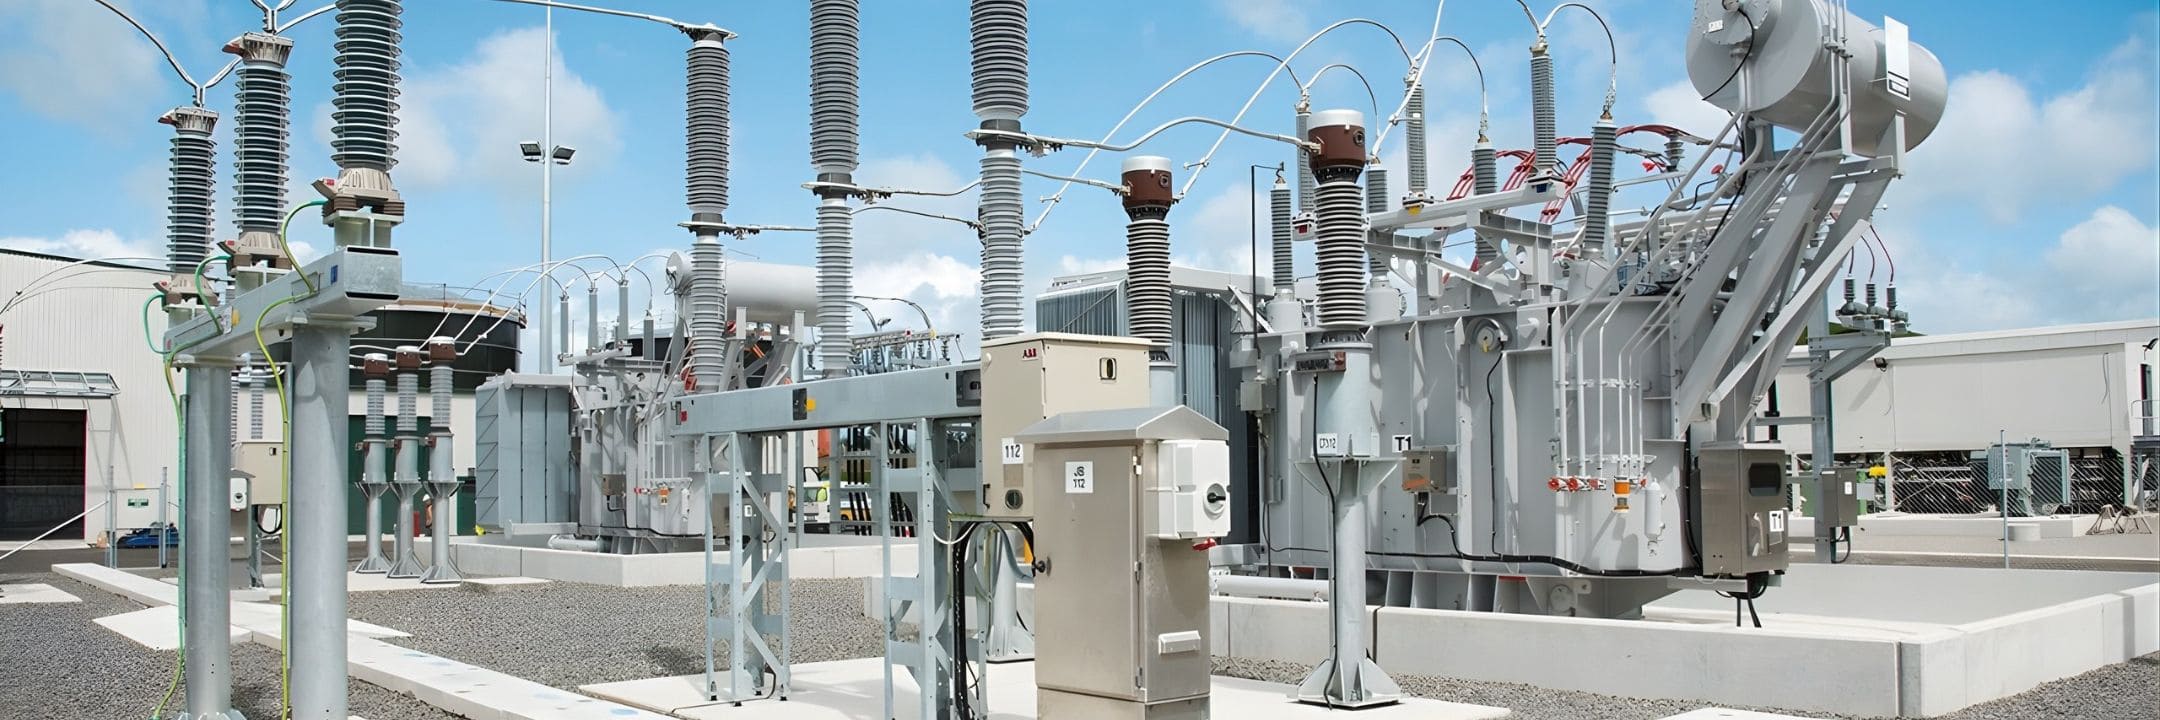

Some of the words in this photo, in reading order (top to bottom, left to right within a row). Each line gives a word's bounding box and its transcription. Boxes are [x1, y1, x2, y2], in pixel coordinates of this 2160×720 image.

[1005, 444, 1021, 458] 112
[1394, 436, 1412, 452] T1
[1771, 513, 1782, 530] T1
